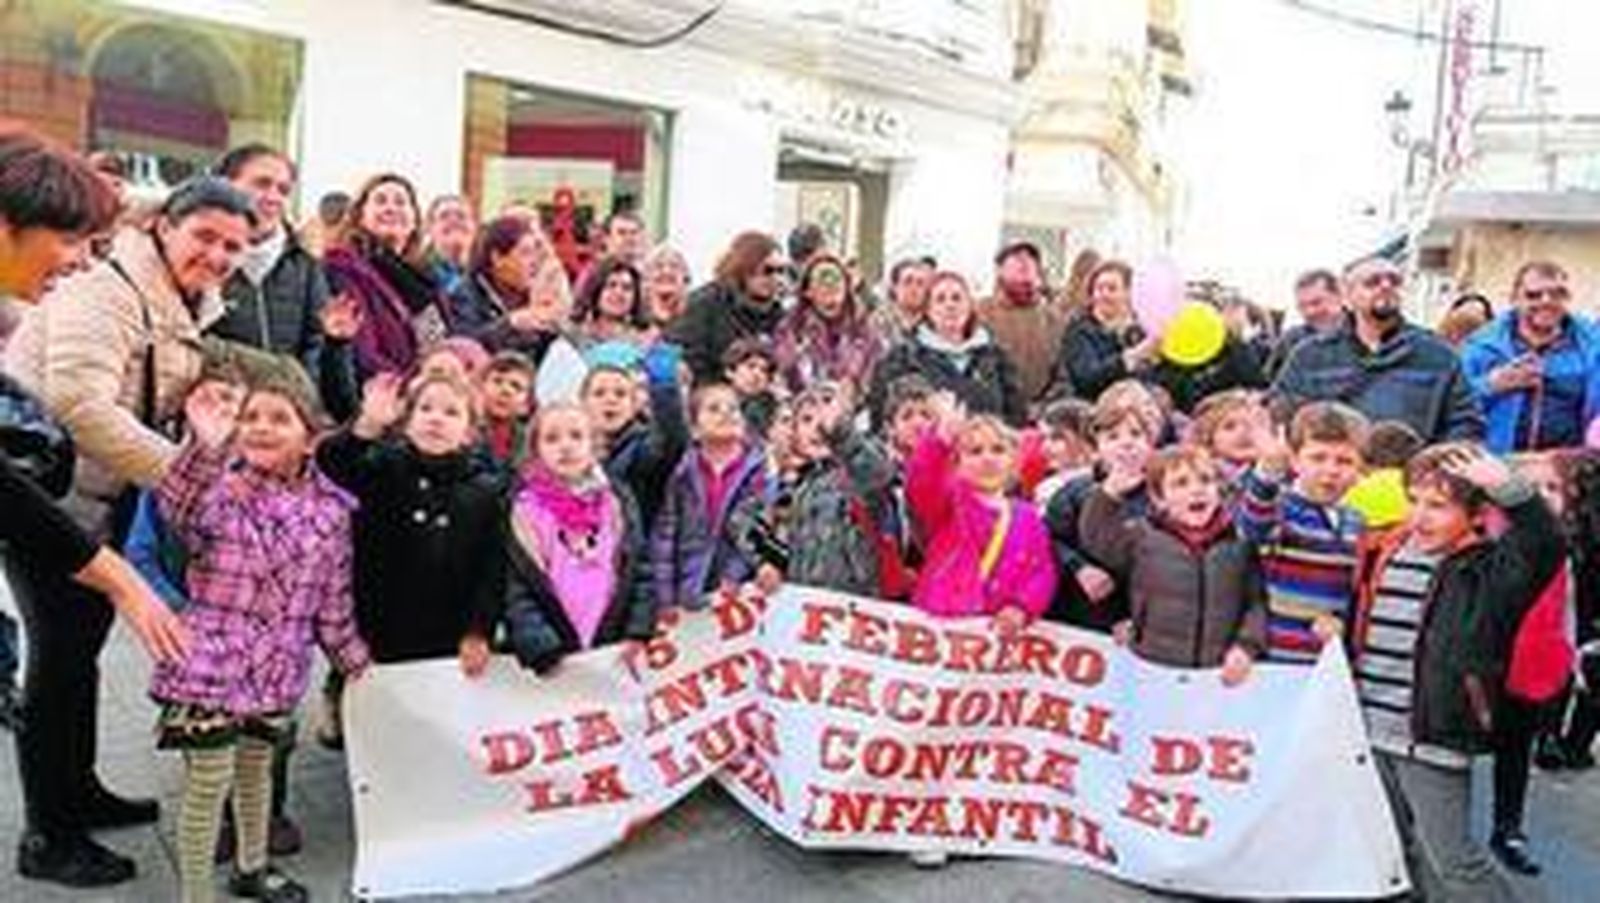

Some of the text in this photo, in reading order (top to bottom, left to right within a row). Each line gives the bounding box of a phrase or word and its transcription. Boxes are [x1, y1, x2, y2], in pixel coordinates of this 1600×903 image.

[481, 710, 622, 775] DIA
[1150, 735, 1255, 783] DE
[525, 765, 634, 813] LA
[818, 726, 1078, 796] CONTRA
[1119, 780, 1211, 839] EL
[801, 784, 1118, 865] INFANTIL
